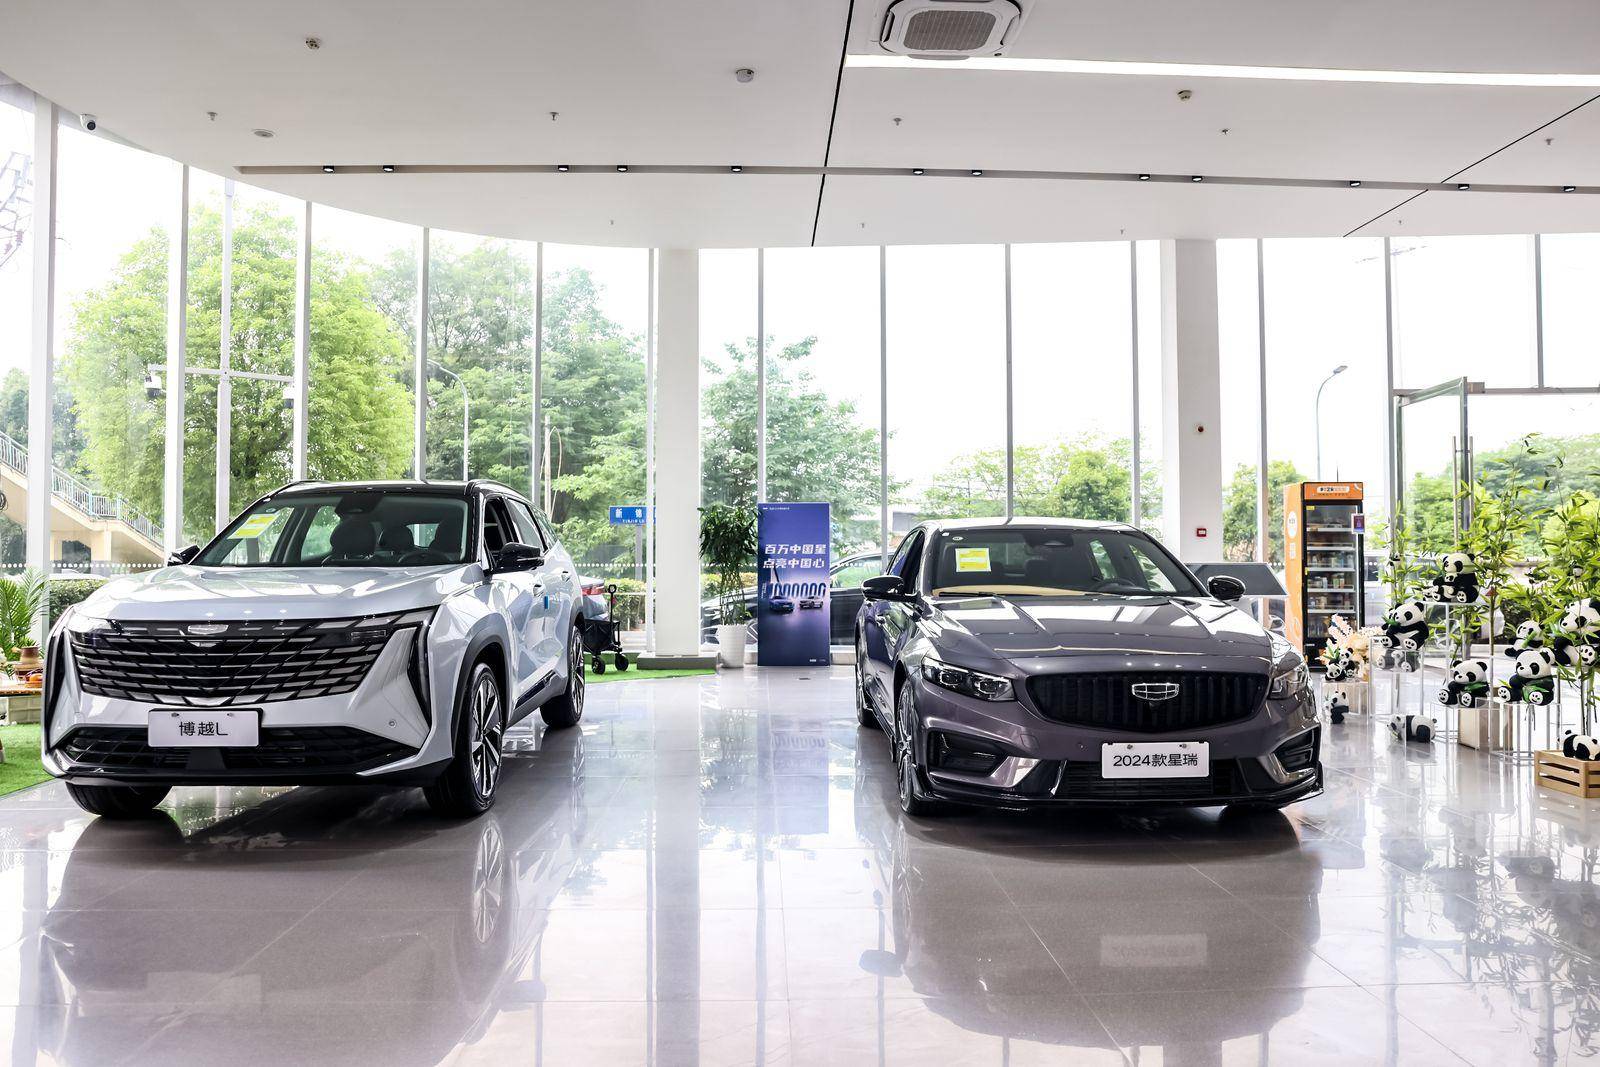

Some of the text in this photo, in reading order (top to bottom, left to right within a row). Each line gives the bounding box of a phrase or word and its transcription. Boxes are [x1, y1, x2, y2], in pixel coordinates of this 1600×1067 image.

[765, 544, 826, 554] 百万中国星
[763, 558, 824, 568] 点亮中国心
[179, 722, 228, 736] 博越L
[1113, 753, 1198, 767] 2024款星瑞
